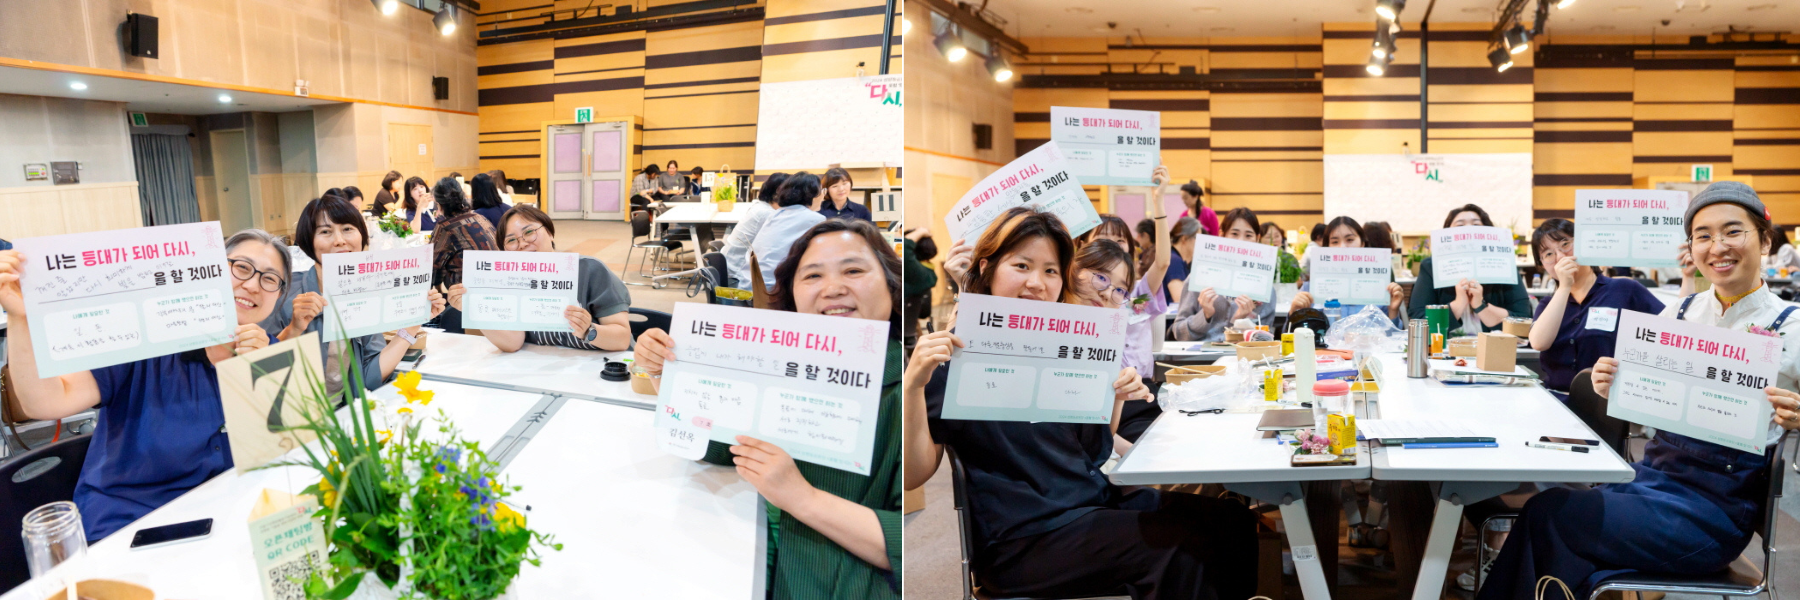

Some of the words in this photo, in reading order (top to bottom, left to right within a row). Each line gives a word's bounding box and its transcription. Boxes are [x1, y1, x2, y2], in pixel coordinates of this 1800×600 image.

[1064, 117, 1080, 126] 나는
[1082, 118, 1106, 128] 등대가
[1108, 118, 1123, 128] 되어
[1125, 120, 1142, 130] 다시,
[1117, 136, 1124, 144] 을
[1127, 136, 1133, 144] 할
[1136, 136, 1156, 146] 것이다
[956, 205, 972, 222] 나는
[972, 186, 999, 208] 등대가
[999, 174, 1020, 191] 되어
[1019, 164, 1044, 181] 다시,
[1020, 191, 1032, 202] 을
[1032, 184, 1042, 196] 할
[1042, 170, 1070, 190] 것이다
[876, 194, 896, 212] 11
[1588, 200, 1604, 208] 나는
[1606, 199, 1630, 208] 등대가
[1633, 200, 1648, 208] 되어
[1650, 200, 1670, 210] 다시,
[1642, 216, 1648, 225] 을
[1652, 216, 1660, 225] 할
[1662, 216, 1683, 226] 것이다
[46, 254, 77, 270] 나는
[82, 248, 128, 267] 등대가
[132, 244, 160, 260] 되어
[163, 240, 196, 258] 다시,
[338, 264, 355, 276] 나는
[358, 262, 383, 274] 등대가
[384, 260, 400, 270] 되어
[402, 258, 420, 268] 다시,
[154, 271, 166, 286] 을
[171, 268, 184, 283] 할
[188, 264, 222, 281] 것이다
[476, 261, 492, 270] 나는
[494, 261, 519, 272] 등대가
[521, 262, 536, 272] 되어
[540, 262, 558, 274] 다시,
[394, 277, 400, 287] 을
[403, 276, 410, 286] 할
[413, 273, 430, 284] 것이다
[530, 280, 538, 290] 을
[540, 280, 548, 290] 할
[551, 280, 573, 290] 것이다
[979, 312, 1004, 328] 나는
[1008, 314, 1045, 332] 등대가
[1048, 318, 1071, 334] 되어
[1074, 320, 1100, 338] 다시,
[692, 320, 716, 338] 나는
[722, 323, 766, 344] 등대가
[770, 328, 800, 348] 되어
[805, 333, 842, 356] 다시,
[1636, 326, 1656, 343] 나는
[1660, 332, 1694, 350] 등대가
[1696, 338, 1720, 356] 되어
[1722, 344, 1750, 364] 다시,
[1058, 345, 1069, 358] 을
[1072, 346, 1084, 360] 할
[1087, 346, 1116, 362] 것이다
[1622, 347, 1650, 363] 누군가를
[1656, 354, 1678, 370] 살리는
[1686, 361, 1694, 374] 일
[785, 361, 799, 378] 을
[806, 364, 820, 381] 할
[826, 367, 871, 389] 것이다
[1706, 366, 1717, 380] 을
[1720, 369, 1732, 384] 할
[1736, 372, 1768, 390] 것이다
[250, 348, 296, 434] 7
[264, 522, 312, 548] 오픈채팅방
[268, 548, 282, 560] QR
[286, 535, 314, 552] CODE
